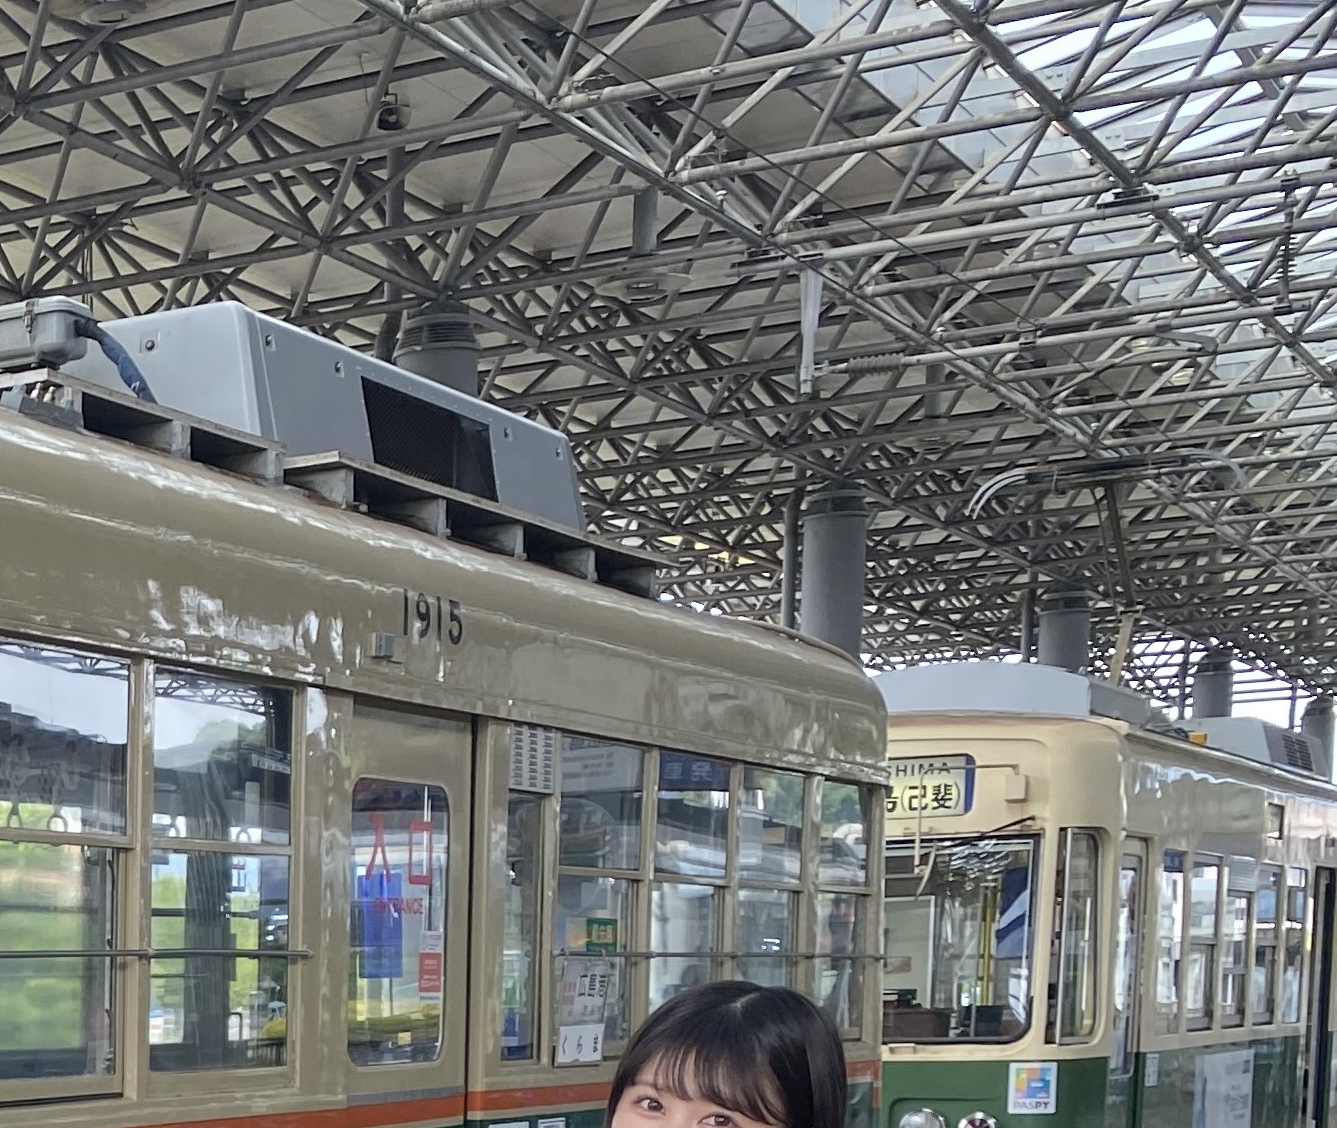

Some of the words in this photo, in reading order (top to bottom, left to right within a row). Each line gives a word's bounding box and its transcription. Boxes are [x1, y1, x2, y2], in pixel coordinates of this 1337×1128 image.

[404, 588, 463, 645] 1915
[365, 812, 434, 885] 入口
[1013, 1101, 1050, 1110] PASPY
